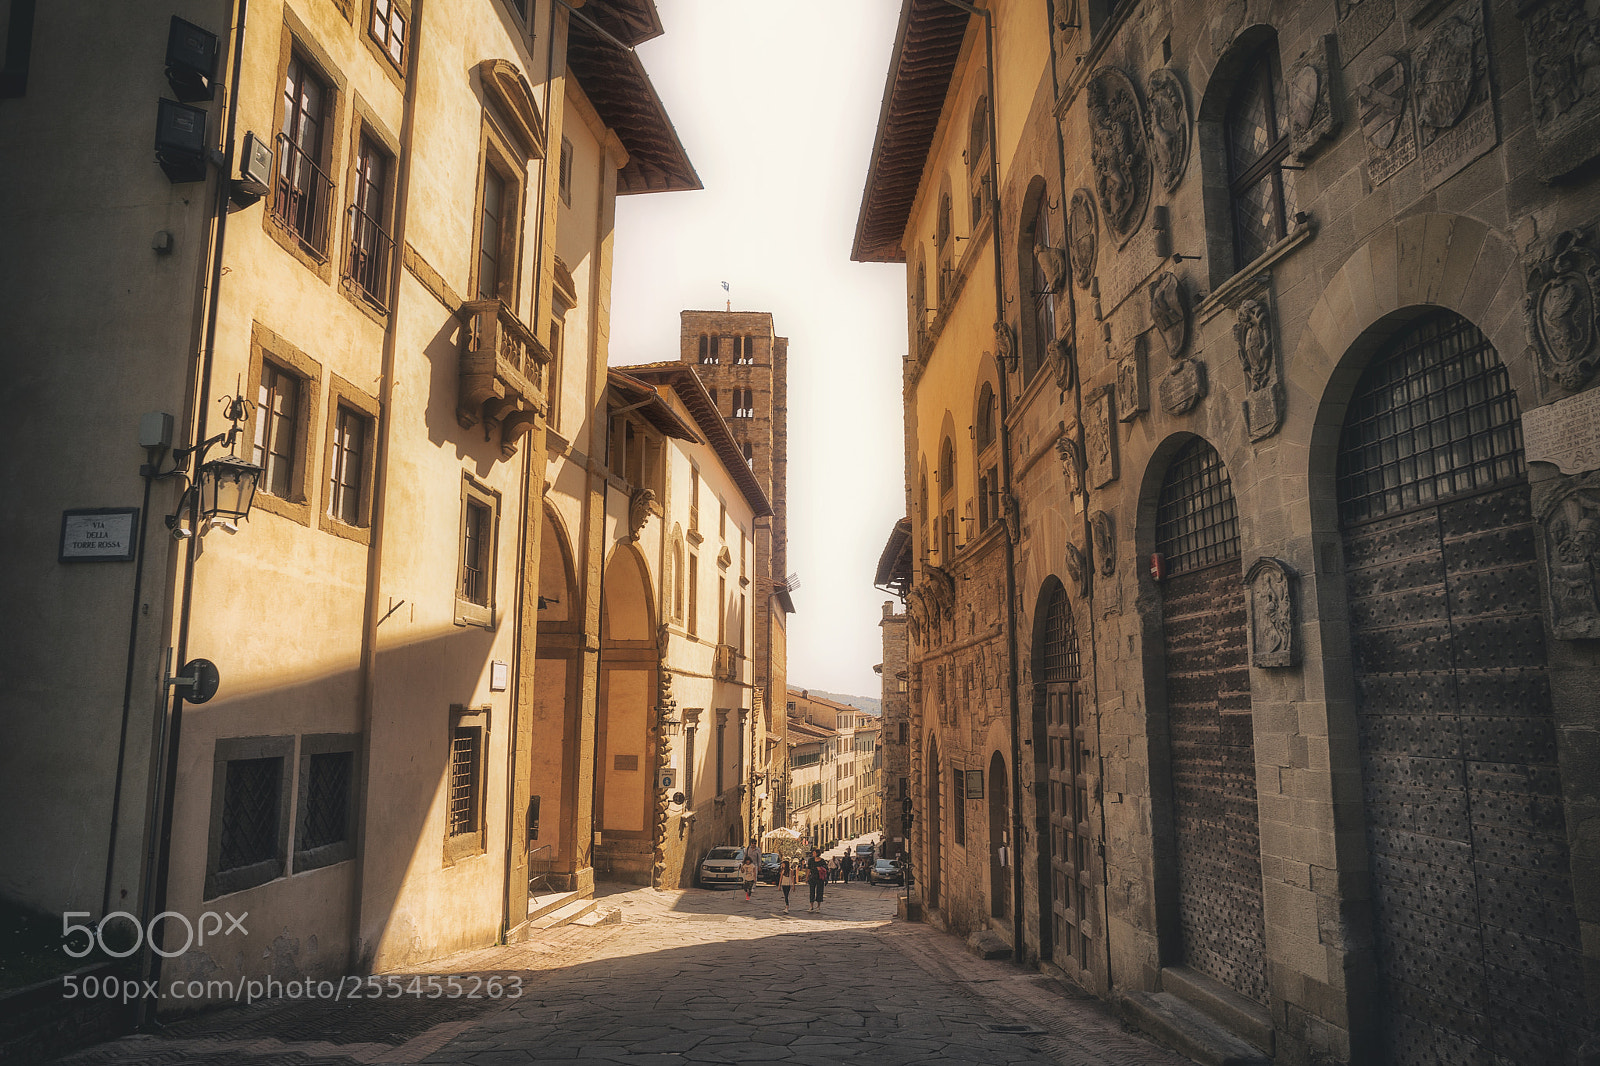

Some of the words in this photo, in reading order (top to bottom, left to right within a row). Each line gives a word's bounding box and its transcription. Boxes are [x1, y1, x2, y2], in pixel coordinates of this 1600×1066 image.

[86, 531, 109, 539] DELLA
[73, 541, 96, 549] TORRE
[97, 541, 121, 549] ROSSA
